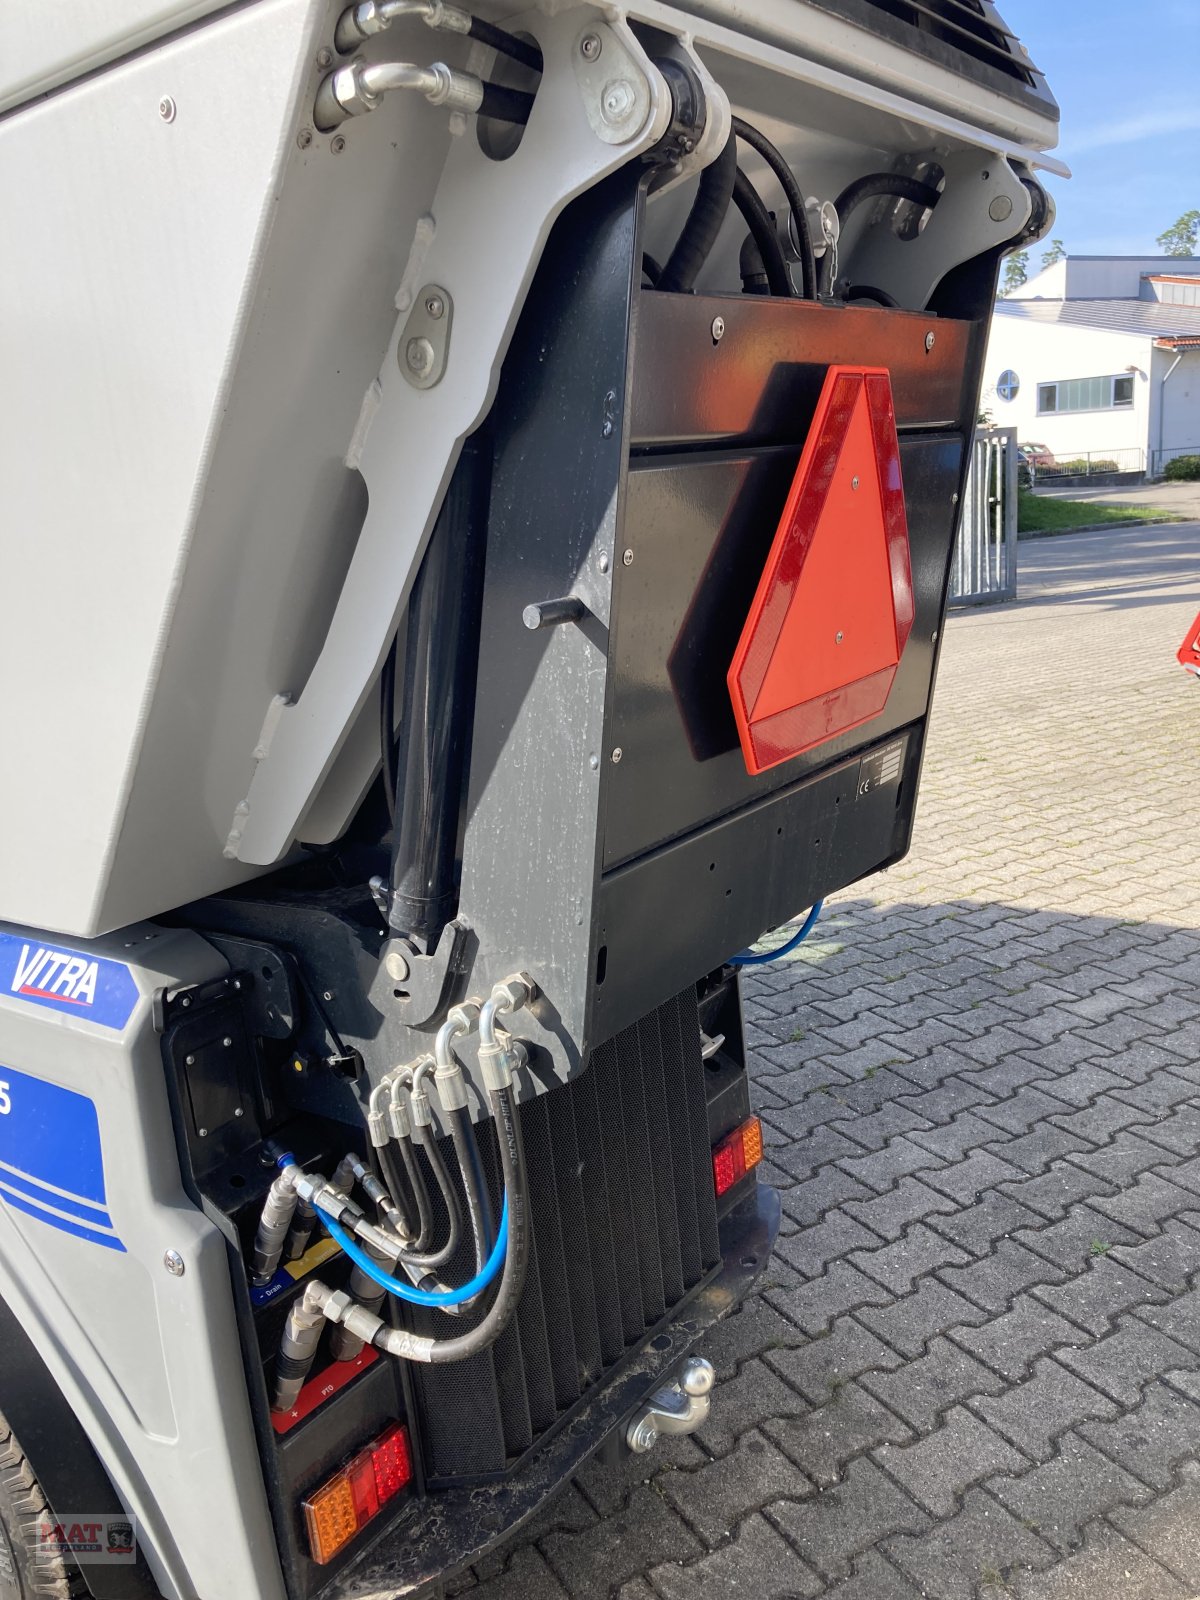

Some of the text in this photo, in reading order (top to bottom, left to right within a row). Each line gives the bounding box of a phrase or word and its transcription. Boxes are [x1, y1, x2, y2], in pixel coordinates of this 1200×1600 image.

[11, 944, 99, 1004] VITRA
[0, 1080, 11, 1115] 5
[504, 1119, 518, 1159] DUNLOP
[265, 1284, 282, 1297] Drain
[321, 1384, 334, 1396] PTO
